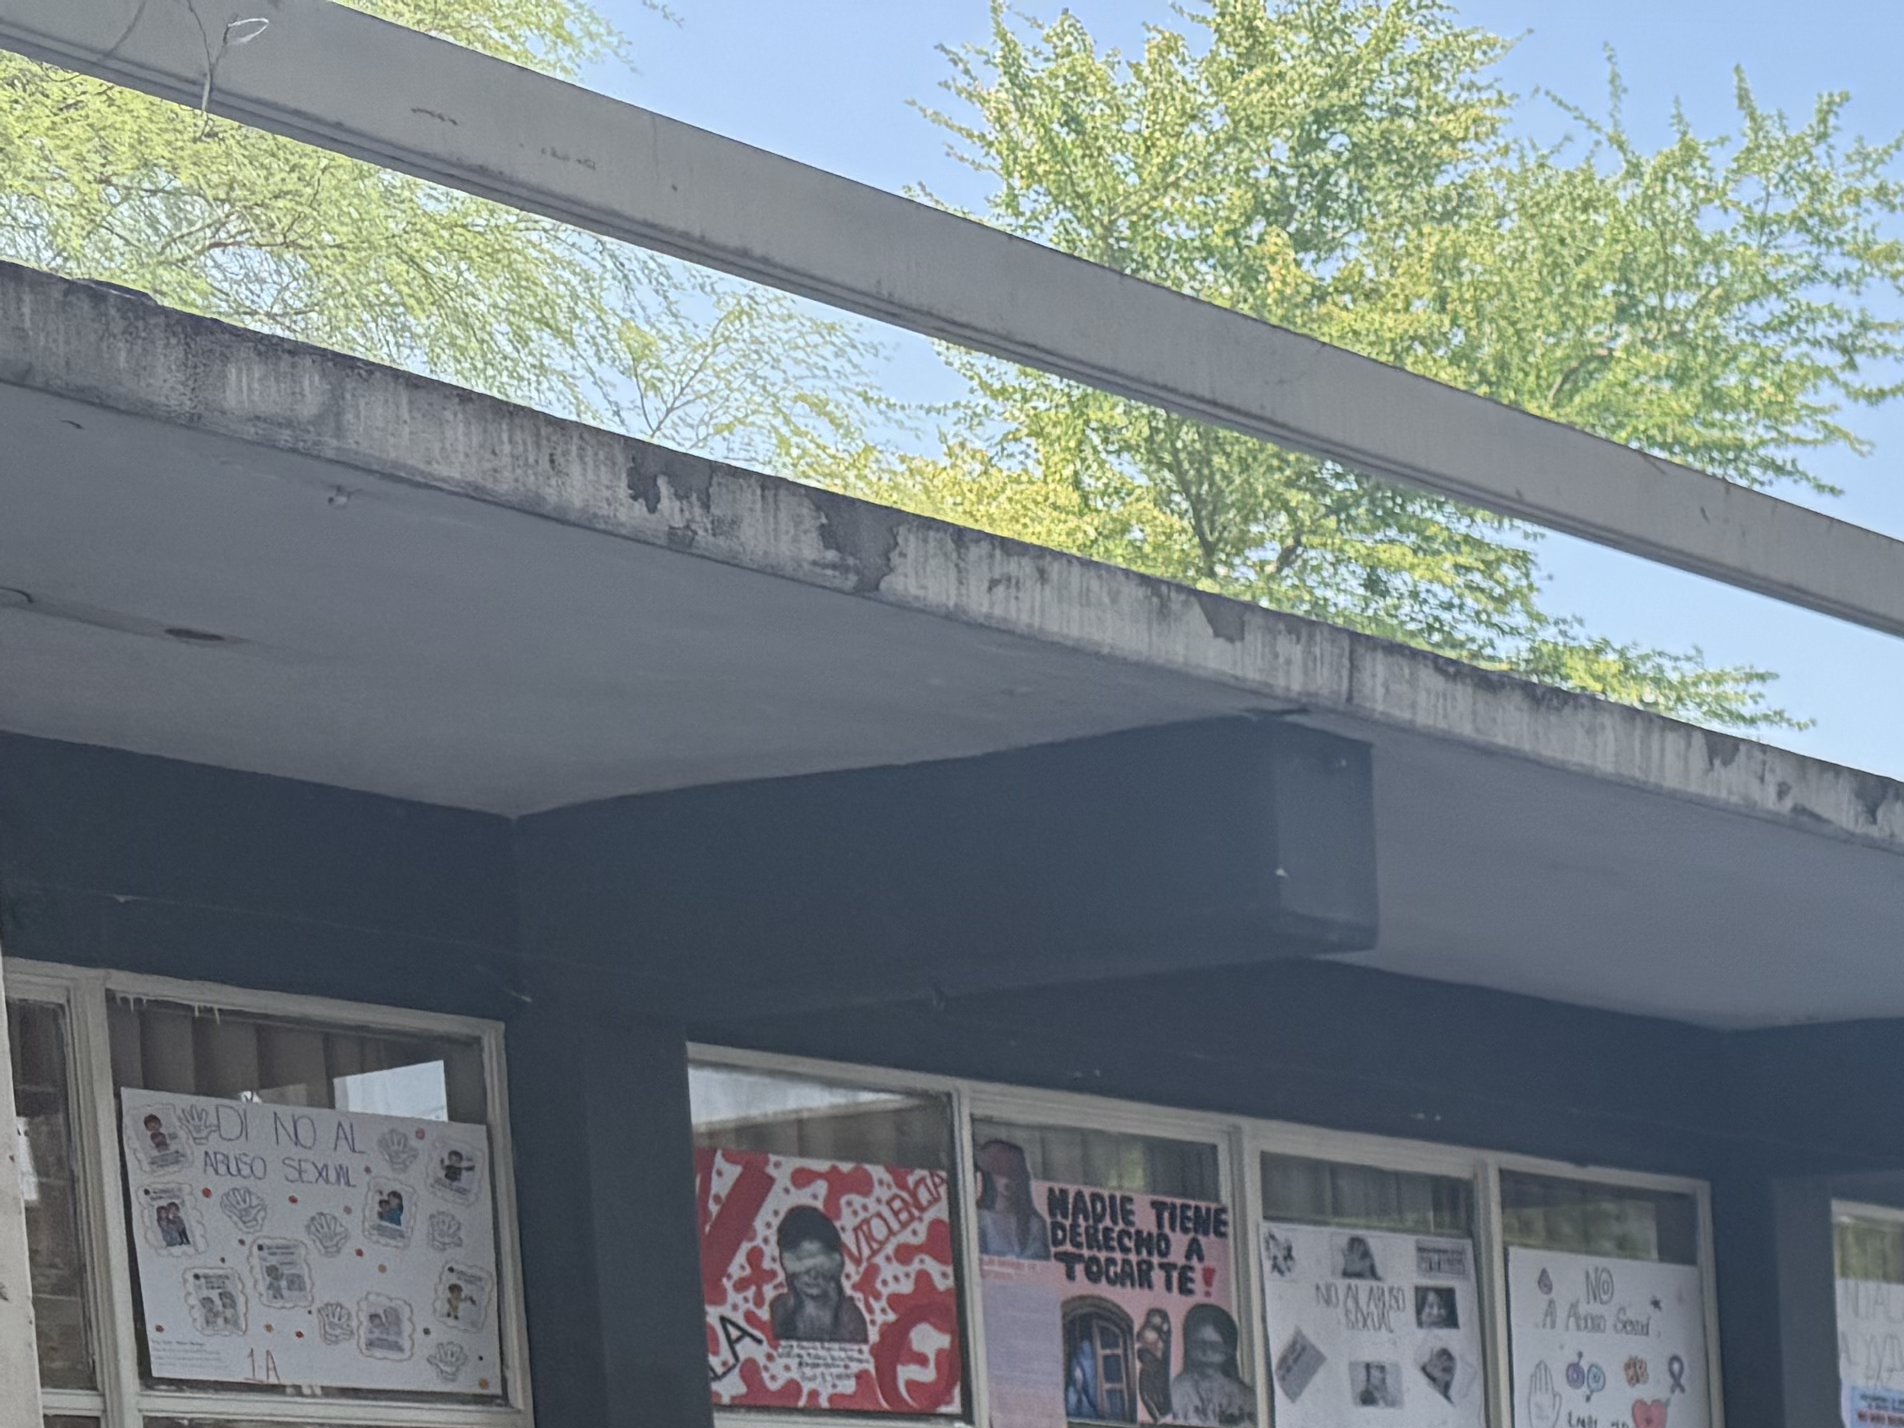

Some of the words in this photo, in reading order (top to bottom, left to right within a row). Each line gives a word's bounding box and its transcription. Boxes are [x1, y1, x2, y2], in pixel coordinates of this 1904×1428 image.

[216, 1104, 249, 1143] DI
[273, 1111, 317, 1150] NO
[332, 1121, 366, 1154] AL
[203, 1150, 267, 1181] ABUSO
[1047, 1186, 1135, 1228] NADIE
[1151, 1200, 1229, 1239] TIENE
[1050, 1220, 1171, 1260] DERECHO
[1185, 1236, 1205, 1264] A
[1585, 1266, 1614, 1305] NO
